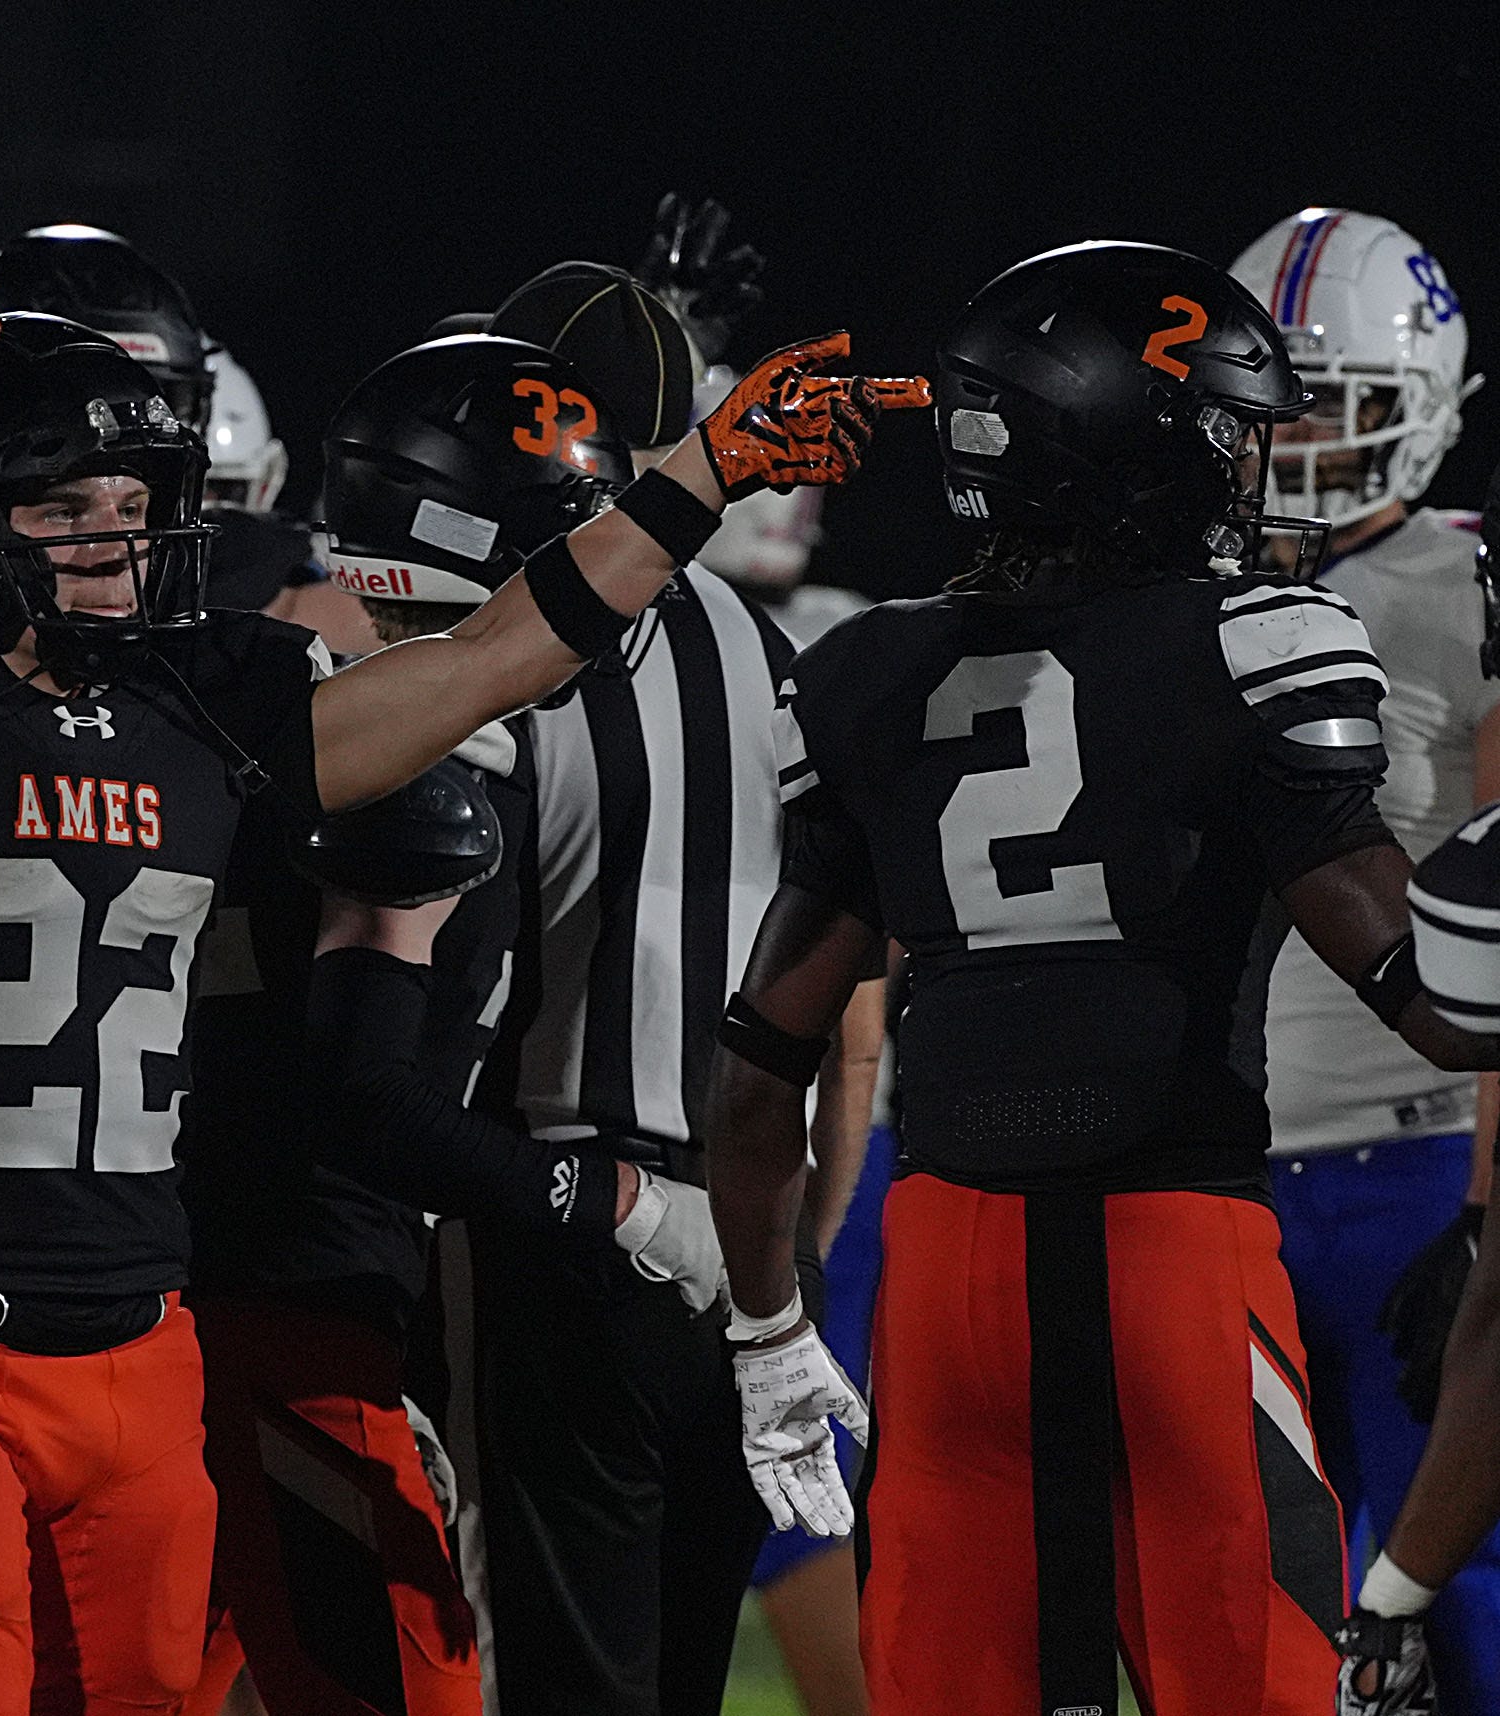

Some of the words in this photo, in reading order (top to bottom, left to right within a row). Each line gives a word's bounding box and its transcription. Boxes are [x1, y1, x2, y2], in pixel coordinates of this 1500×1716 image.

[1140, 294, 1209, 382] 2
[511, 377, 598, 476] 32
[947, 485, 991, 519] dell
[328, 562, 413, 596] ddell
[14, 773, 164, 850] AMES
[922, 649, 1125, 951] 2
